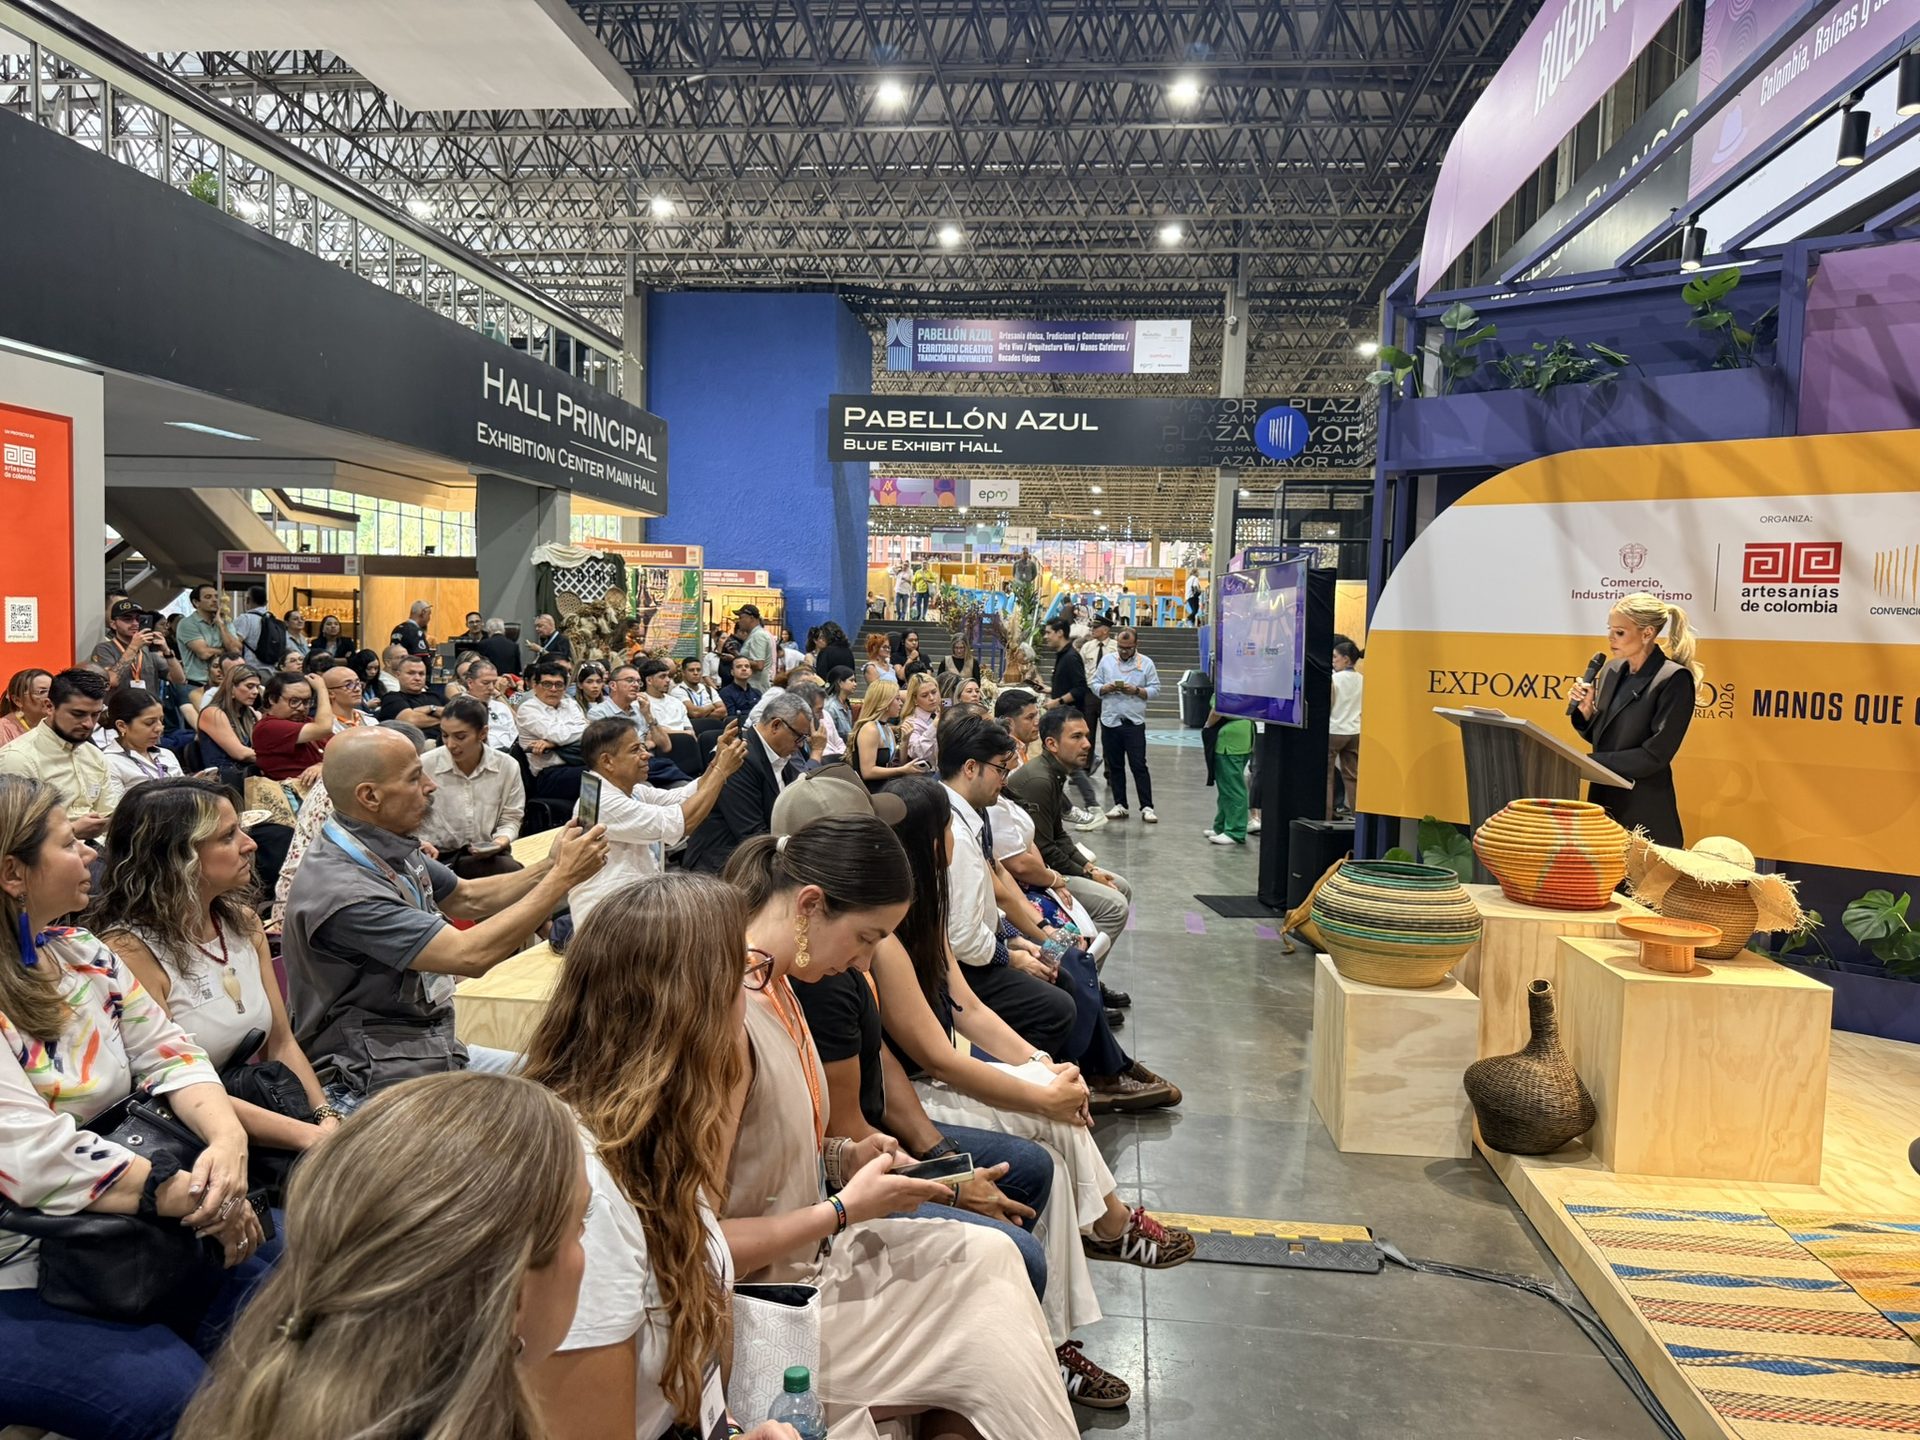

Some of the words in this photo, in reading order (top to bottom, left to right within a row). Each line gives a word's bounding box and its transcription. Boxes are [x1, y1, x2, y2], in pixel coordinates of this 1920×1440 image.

[1760, 43, 1810, 106] Colombia,
[1814, 2, 1858, 60] Raíces
[918, 326, 966, 340] PABELLÓN
[969, 328, 993, 342] AZUL
[918, 344, 958, 353] TERRITORIO
[960, 344, 993, 354] CREATIVO
[484, 361, 551, 422] HALL
[557, 392, 657, 462] PRINCIPAL
[844, 406, 1007, 430] PABELLÓN
[1015, 409, 1099, 431] AZUL
[843, 438, 888, 451] BLUE
[891, 440, 956, 452] EXHIBIT
[960, 441, 1003, 453] HALL
[477, 421, 555, 464] EXHIBITION
[558, 448, 604, 480] CENTER
[606, 464, 632, 488] MAIN
[634, 475, 657, 496] HALL
[1760, 515, 1813, 523] ORGANIZA:
[253, 557, 262, 568] 14
[1601, 577, 1663, 588] Comercio,
[1571, 589, 1625, 600] Industria
[1741, 585, 1839, 598] artesanías
[1740, 600, 1759, 612] de
[1764, 600, 1837, 613] colombia
[1718, 683, 1735, 719] 2026
[1753, 689, 1843, 721] MANOS
[1854, 694, 1903, 725] QUE
